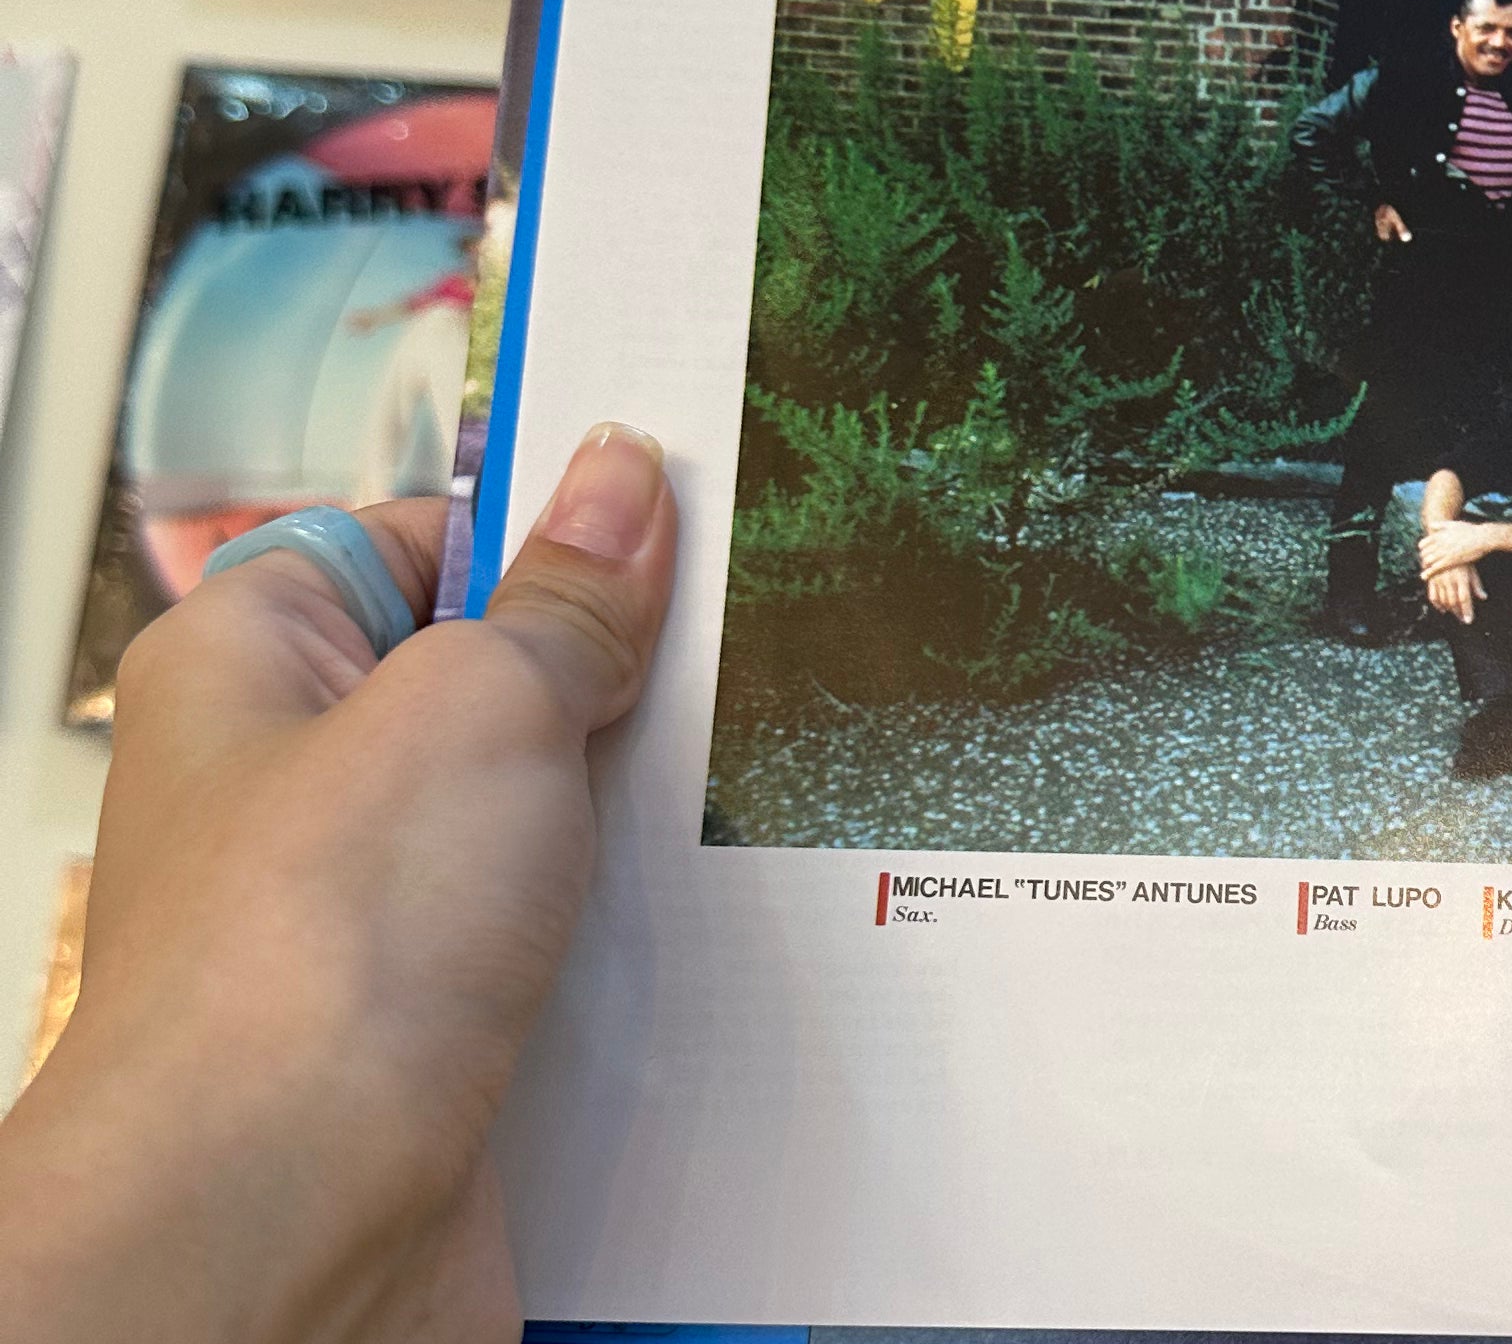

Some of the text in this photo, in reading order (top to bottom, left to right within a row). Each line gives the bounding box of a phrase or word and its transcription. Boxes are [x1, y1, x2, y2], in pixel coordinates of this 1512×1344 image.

[891, 875, 1009, 901] MICHAEL
[1131, 881, 1258, 906] ANTUNES
[1310, 885, 1442, 910] PAT LUPO
[891, 904, 939, 924] Sax.
[1312, 913, 1358, 932] Bass
